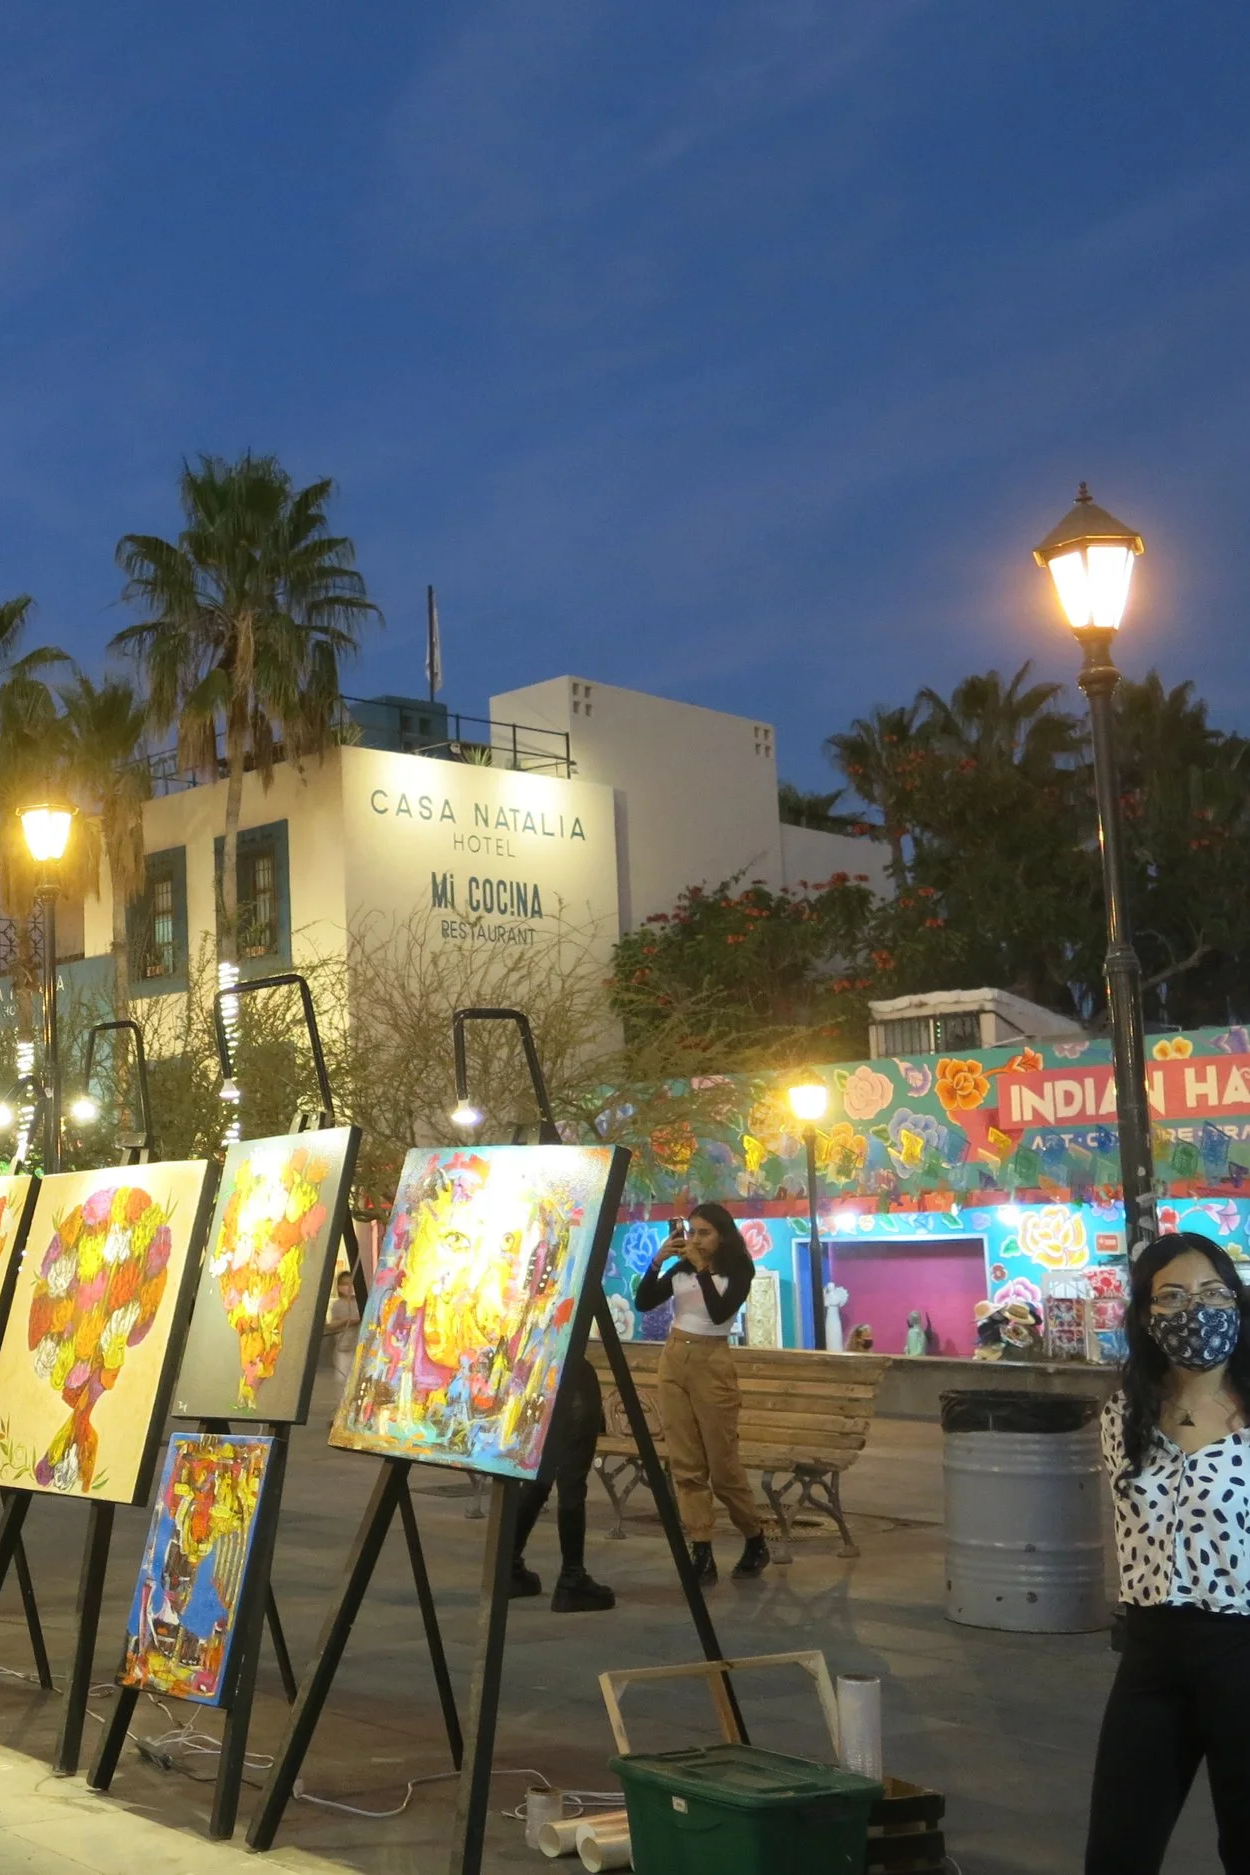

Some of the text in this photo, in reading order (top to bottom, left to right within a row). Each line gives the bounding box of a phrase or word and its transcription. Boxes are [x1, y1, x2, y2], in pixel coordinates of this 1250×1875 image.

[370, 789, 586, 841] CASA NATALIA
[453, 832, 516, 858] HOTEL
[441, 919, 536, 946] RESTAURANT
